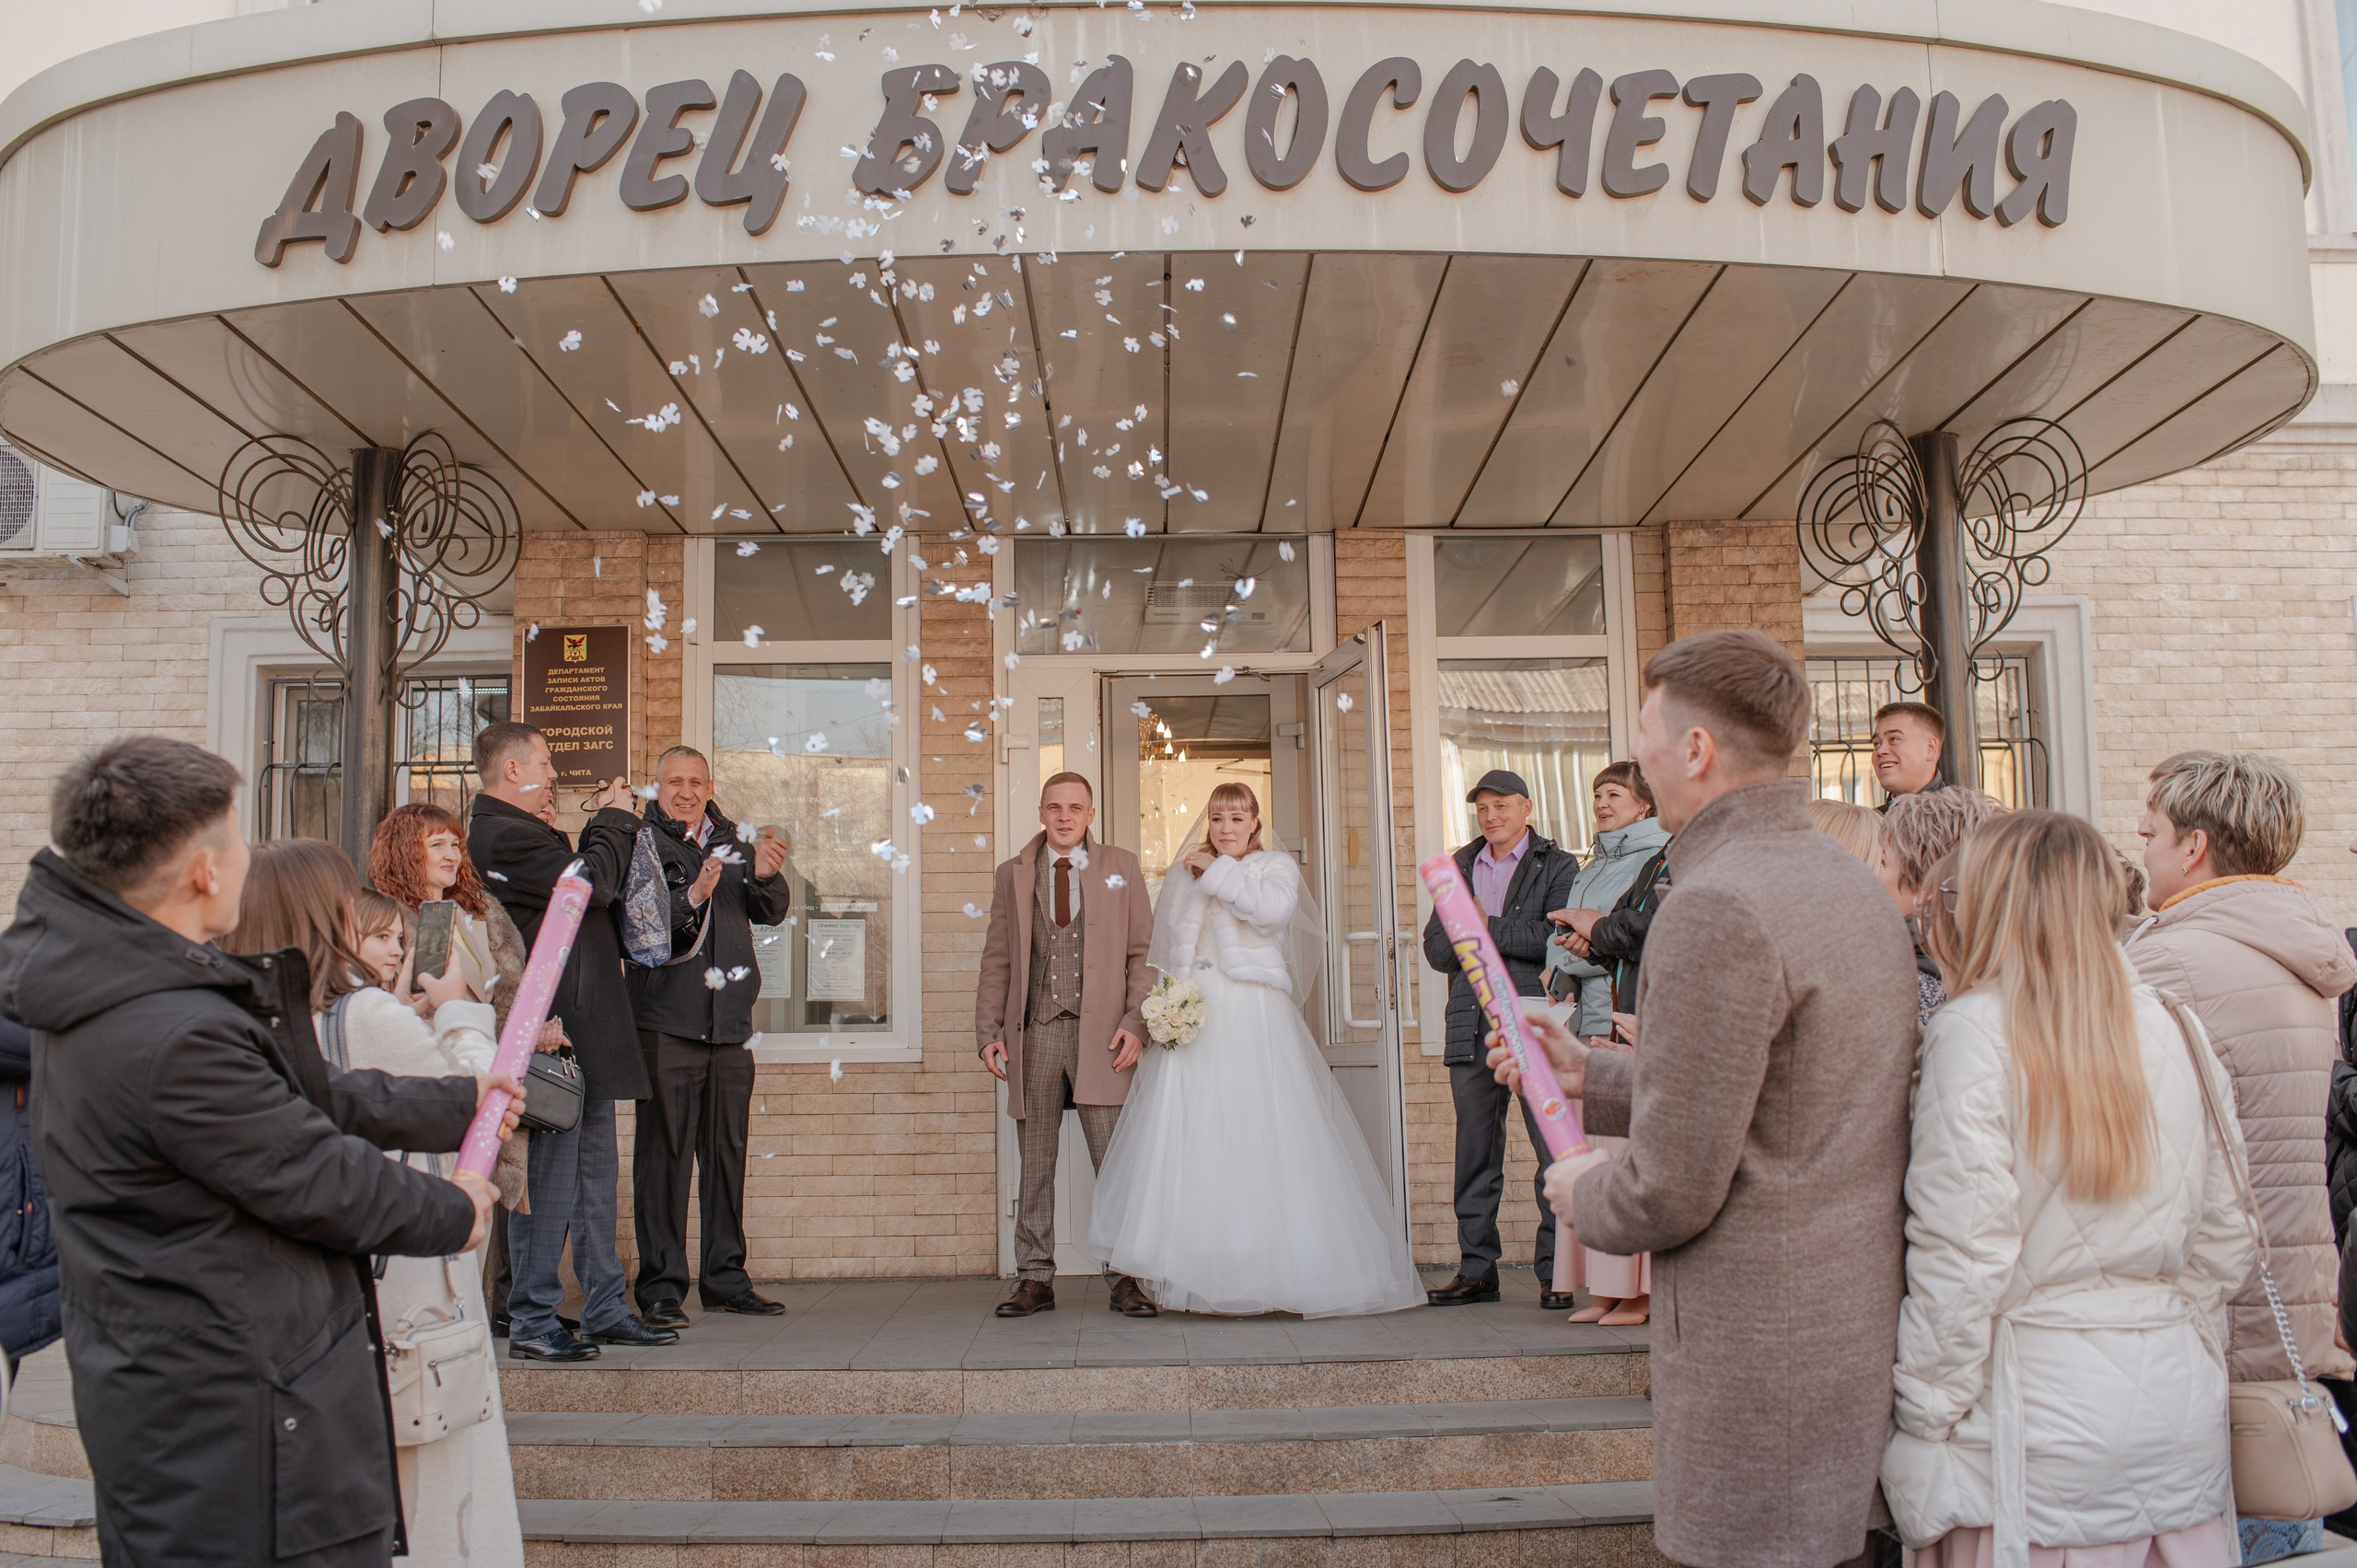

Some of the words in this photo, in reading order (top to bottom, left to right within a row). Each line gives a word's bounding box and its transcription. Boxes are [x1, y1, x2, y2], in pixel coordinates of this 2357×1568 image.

[254, 69, 807, 269] ДВОРЕЦ
[851, 53, 2078, 228] БРАКОСОЧЕТАНИЯ
[548, 668, 605, 676] ДЕПАРТАМЕНТ
[545, 685, 608, 693] ГРАЖДАНСКОГО
[530, 703, 601, 713] ЗАБАЙКАЛЬСКОГО
[547, 741, 580, 753] ТДЕЛ
[583, 740, 614, 750] ЗАГС
